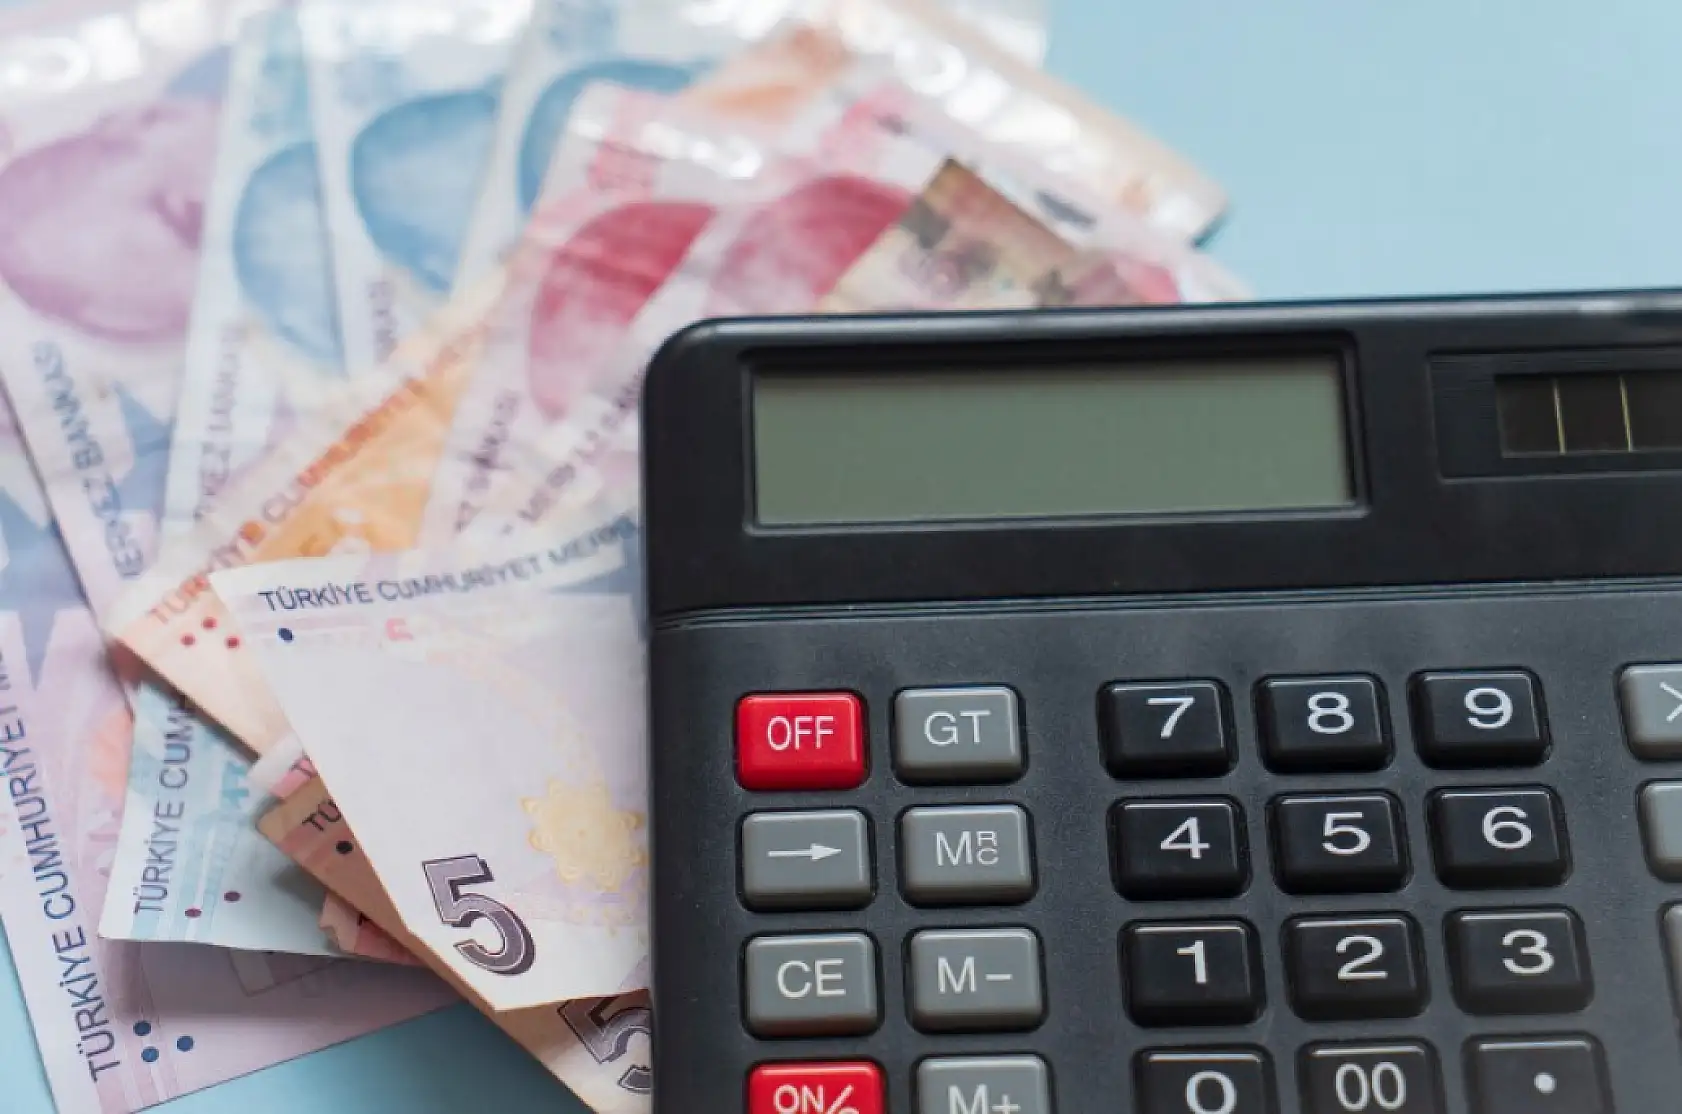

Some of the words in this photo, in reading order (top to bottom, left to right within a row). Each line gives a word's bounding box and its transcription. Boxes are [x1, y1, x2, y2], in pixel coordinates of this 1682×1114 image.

[257, 581, 374, 613] TÜRKİYE
[376, 554, 543, 601] CUMHURİYET
[924, 710, 991, 746] GT
[1146, 696, 1195, 738] 7
[1307, 691, 1355, 735] 8
[1464, 687, 1513, 729] 9
[767, 715, 835, 751] OFF
[1160, 816, 1210, 859] 4
[1322, 811, 1371, 855] 5
[1482, 806, 1532, 849] 6
[133, 801, 185, 915] TÜRKİYE
[422, 854, 537, 976] 5
[1176, 940, 1208, 984] 1
[1334, 935, 1388, 980] 2
[1501, 929, 1555, 974] 3
[777, 958, 847, 998] CE
[52, 924, 120, 1083] TÜRKİYE
[1186, 1071, 1237, 1114] 0
[1334, 1061, 1406, 1110] 00
